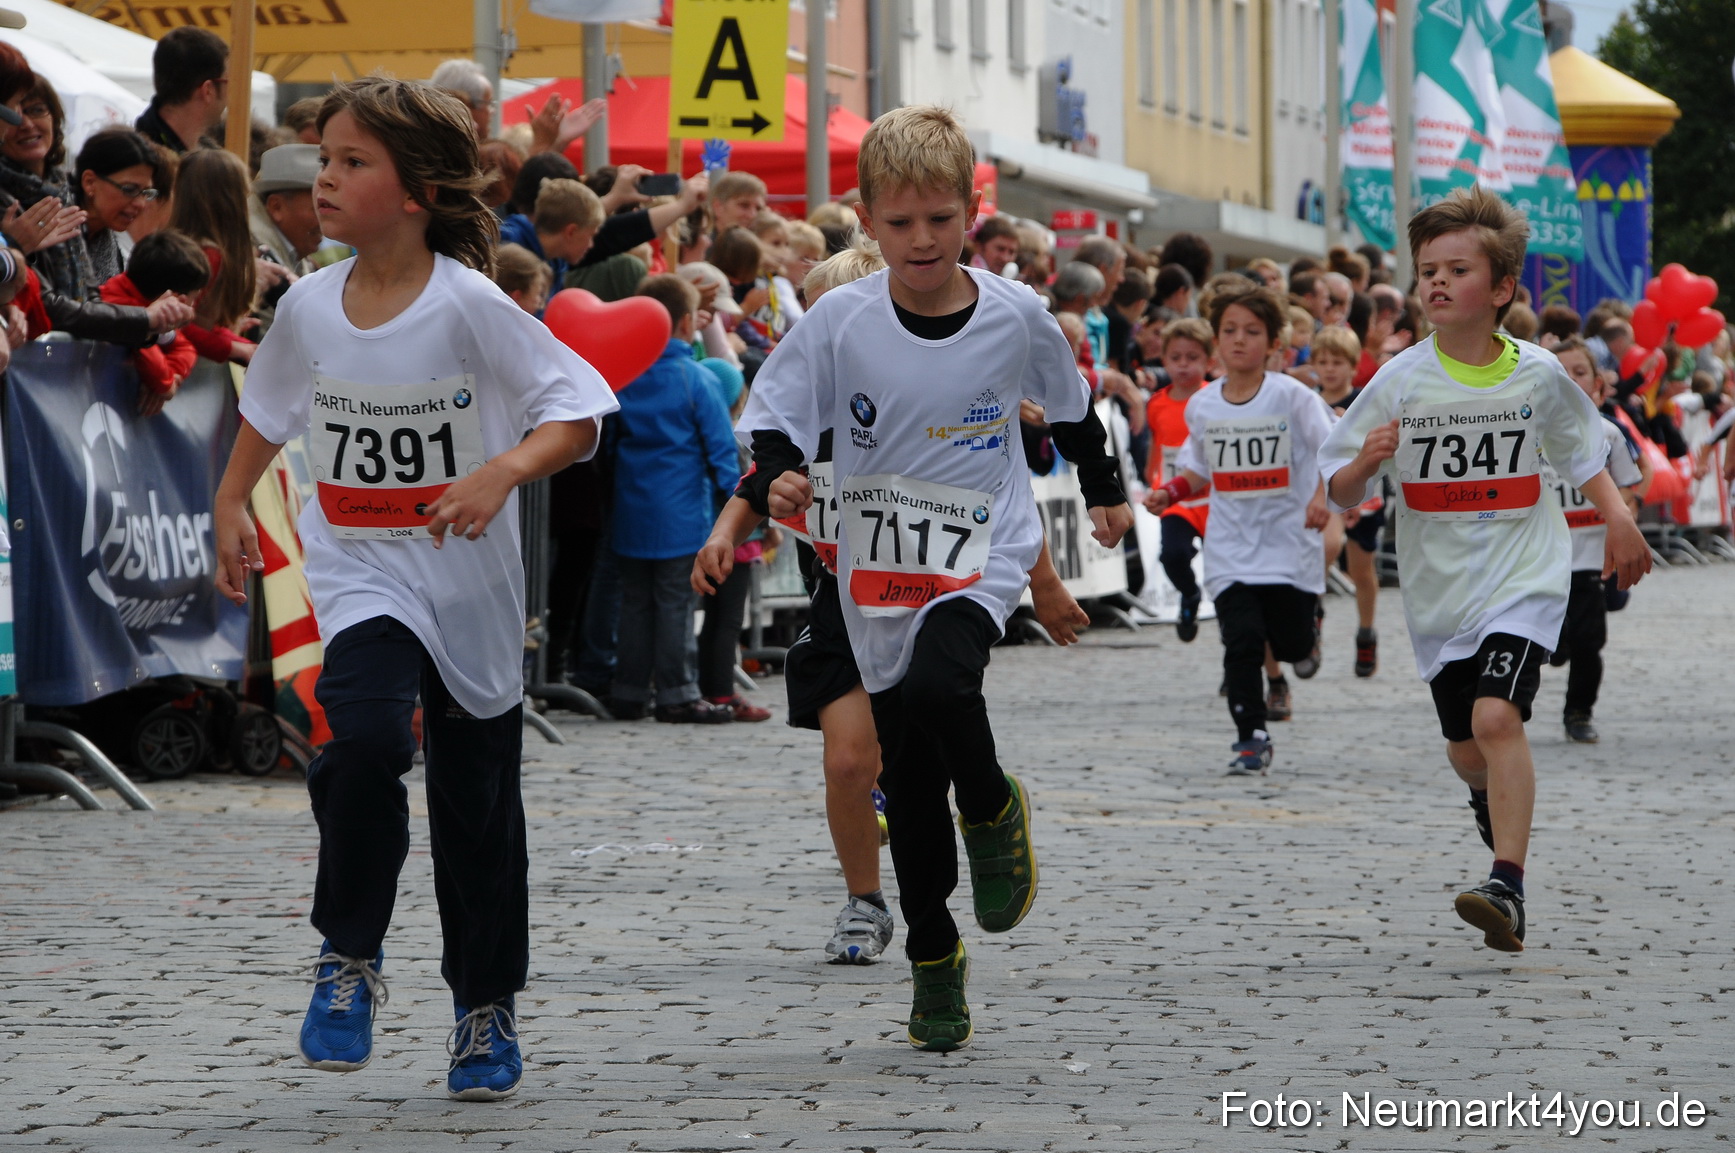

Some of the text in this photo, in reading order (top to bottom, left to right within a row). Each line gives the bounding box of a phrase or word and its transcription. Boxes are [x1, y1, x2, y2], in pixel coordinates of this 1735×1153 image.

[694, 16, 759, 101] A
[314, 392, 447, 416] PARTL Neumarkt
[926, 426, 951, 439] 14.
[1402, 410, 1517, 429] PARTL Neumarkt
[325, 421, 457, 484] 7391
[1213, 436, 1280, 467] 7107
[1412, 429, 1526, 478] 7347
[1228, 475, 1269, 489] Tobias
[337, 496, 403, 515] Constantin
[842, 489, 966, 519] PARTL Neumarkt
[99, 489, 211, 582] Fischer
[388, 528, 413, 537] 2006
[860, 510, 972, 571] 7117
[879, 580, 937, 602] Jannik
[1482, 650, 1514, 677] 13
